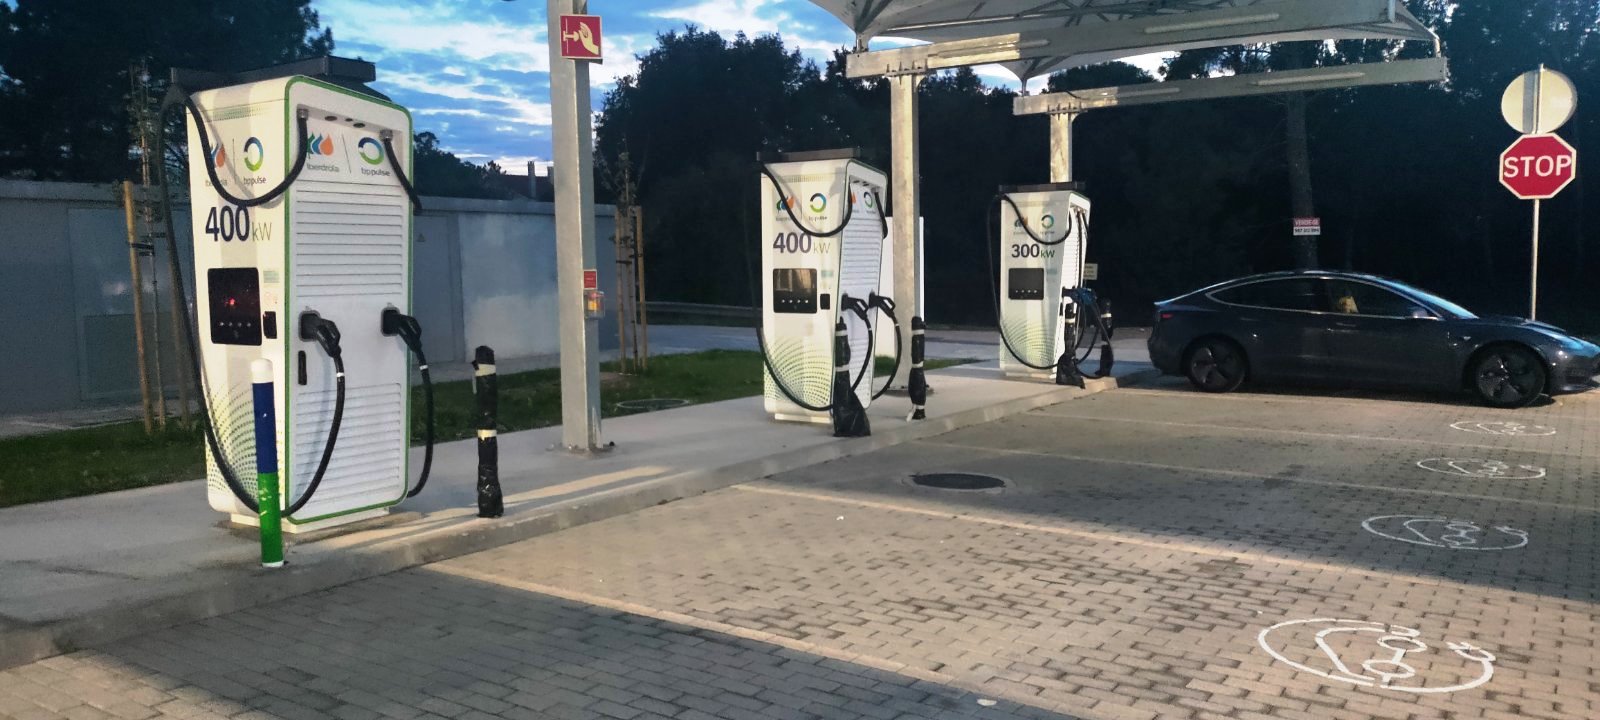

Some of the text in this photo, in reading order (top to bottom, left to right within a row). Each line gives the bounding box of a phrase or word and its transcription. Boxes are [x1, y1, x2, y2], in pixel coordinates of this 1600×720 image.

[1503, 154, 1572, 178] STOP
[205, 205, 272, 242] 400 kW
[773, 232, 831, 254] 400 kW
[1011, 244, 1055, 258] 300 kW
